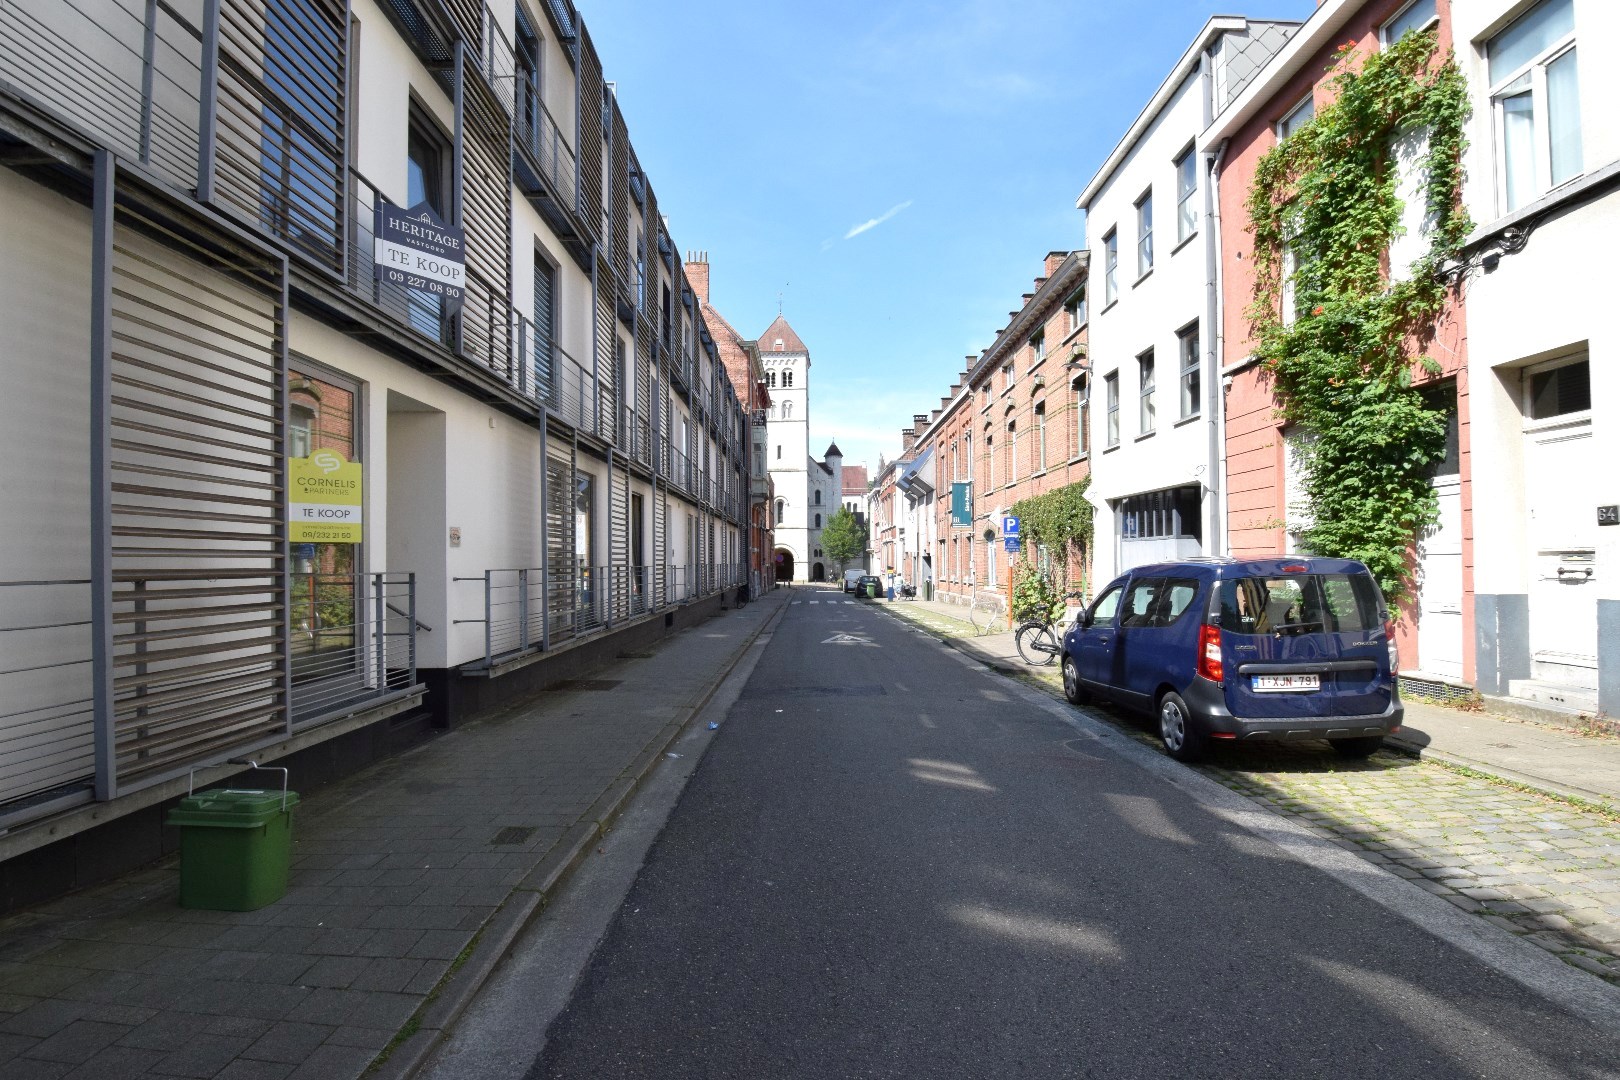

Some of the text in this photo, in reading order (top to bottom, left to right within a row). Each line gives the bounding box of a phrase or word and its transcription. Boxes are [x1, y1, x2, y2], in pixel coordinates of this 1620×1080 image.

[389, 217, 460, 249] HERITAGE
[388, 248, 460, 279] TE KOOP
[389, 271, 460, 298] 09 227 08 90
[297, 477, 356, 488] CORNELIS
[303, 509, 351, 518] TE KOOP
[1599, 508, 1615, 521] 64
[1007, 519, 1015, 531] P
